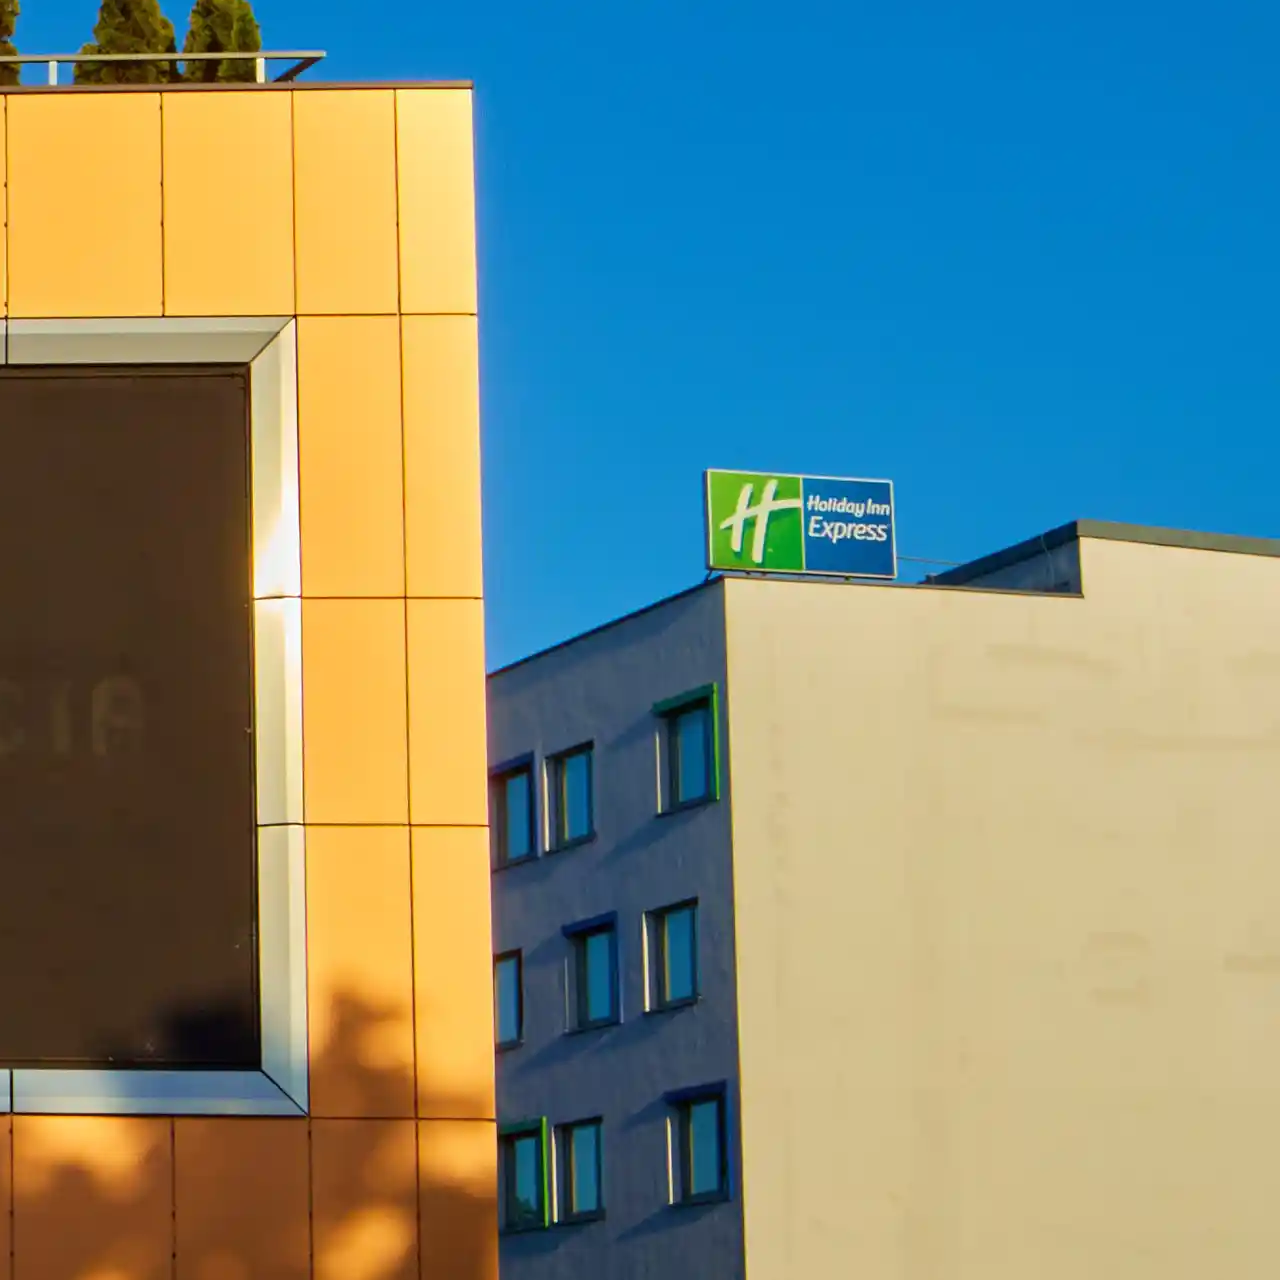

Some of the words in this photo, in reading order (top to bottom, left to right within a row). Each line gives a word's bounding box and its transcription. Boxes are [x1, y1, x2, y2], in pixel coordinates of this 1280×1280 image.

[807, 494, 865, 518] Holiday
[866, 498, 890, 516] Inn
[808, 515, 888, 544] Express
